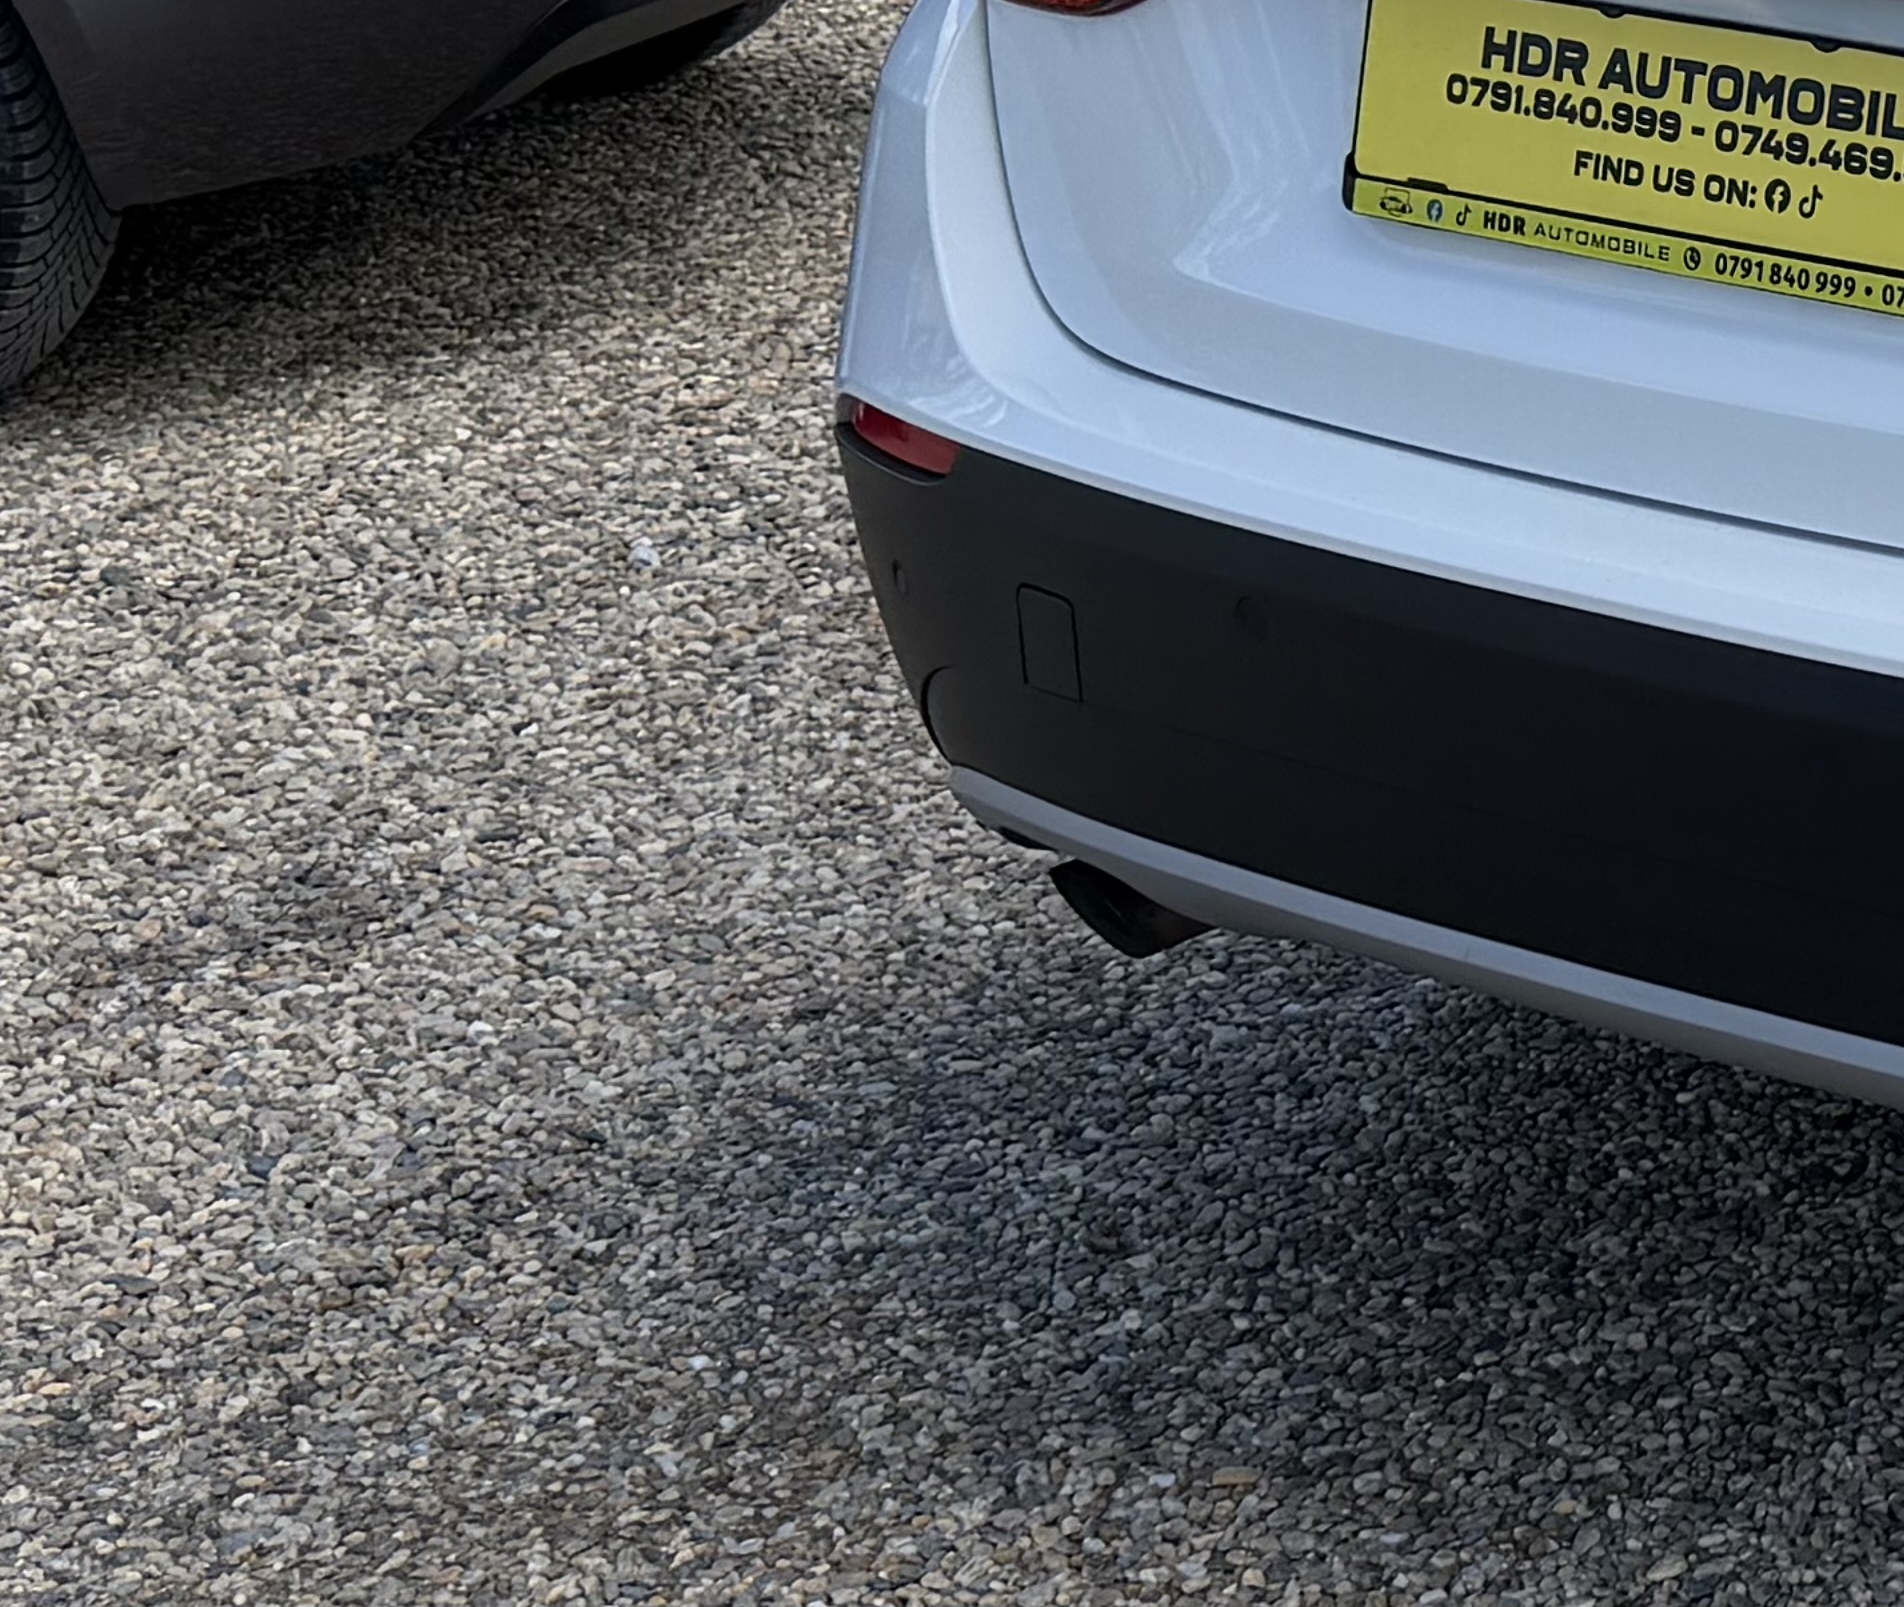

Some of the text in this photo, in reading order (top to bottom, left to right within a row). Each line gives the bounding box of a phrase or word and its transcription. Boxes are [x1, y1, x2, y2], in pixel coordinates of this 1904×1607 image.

[1480, 25, 1590, 87] HDR
[1446, 72, 1682, 143] 0791.840.999
[1573, 149, 1757, 209] FIND US ON:
[1483, 210, 1526, 237] HDR
[1533, 221, 1670, 262] AUTOMOBILE
[1714, 252, 1764, 283] 0791
[1768, 262, 1811, 291] 840
[1814, 272, 1857, 298] 999
